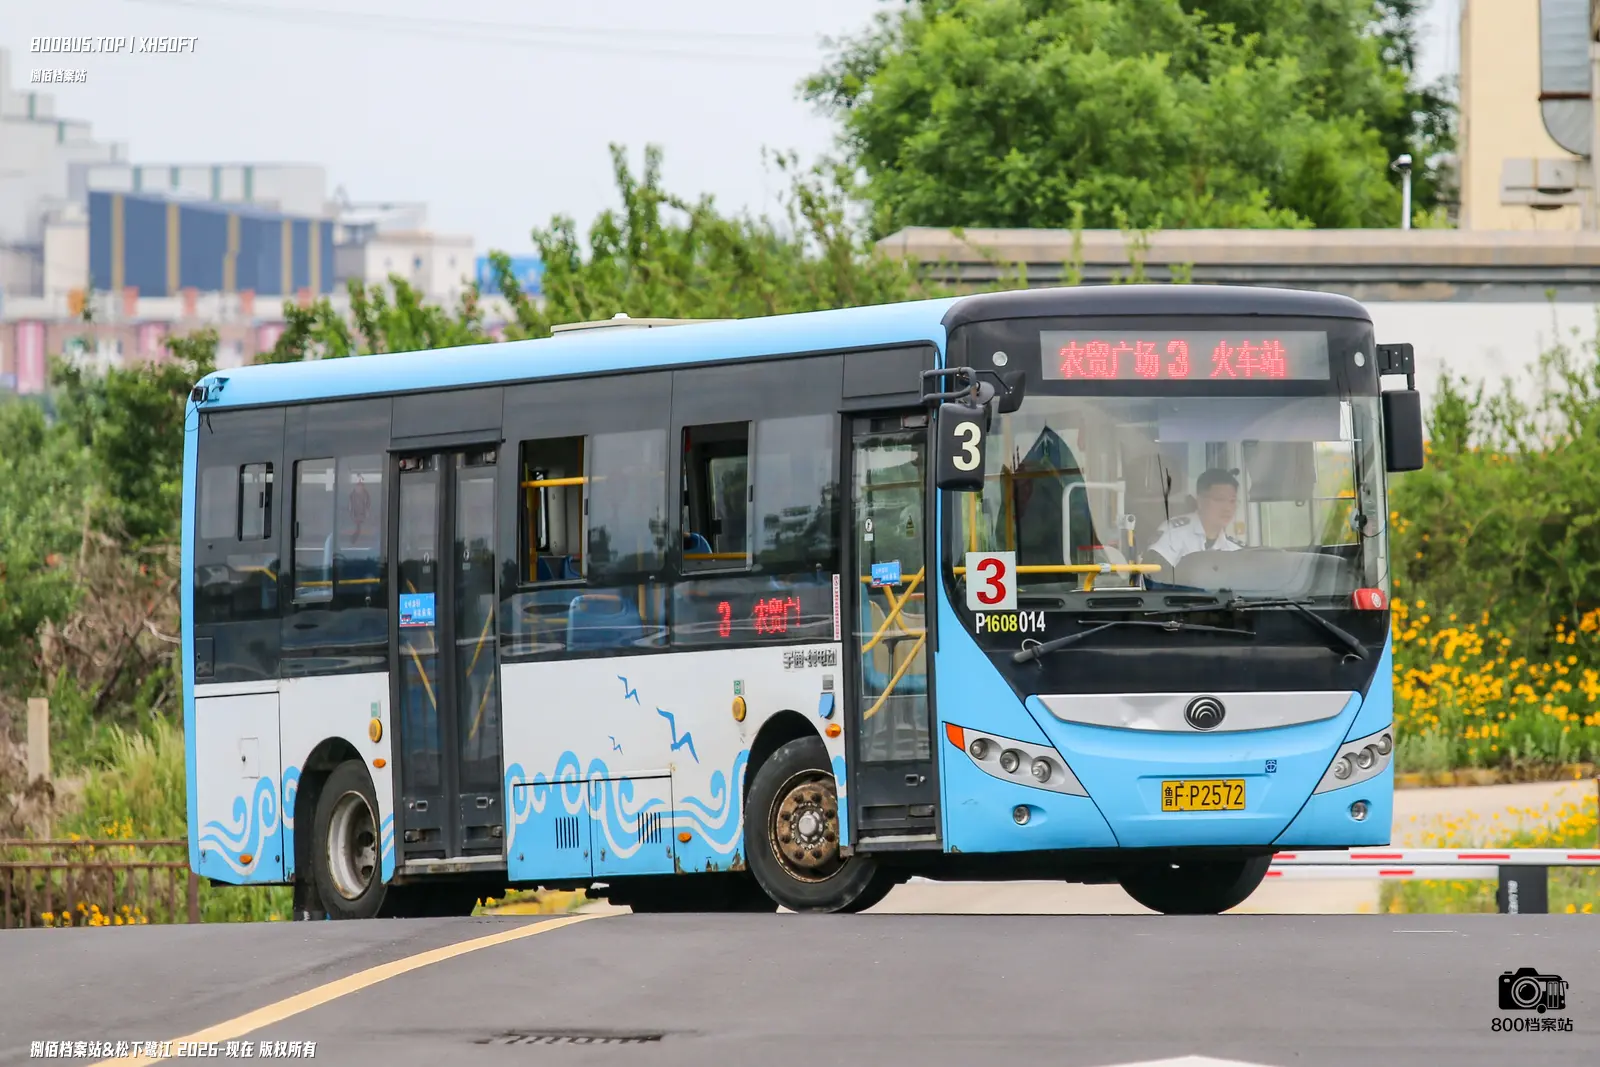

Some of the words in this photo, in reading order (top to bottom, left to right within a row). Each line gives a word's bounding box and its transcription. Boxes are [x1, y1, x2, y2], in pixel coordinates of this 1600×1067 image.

[1059, 340, 1160, 378] 农贸广场
[1167, 340, 1190, 378] 3
[1211, 340, 1286, 378] 火车站
[952, 421, 982, 472] 3
[976, 557, 1007, 605] 3
[717, 601, 731, 637] 3
[975, 611, 1046, 634] P1608014
